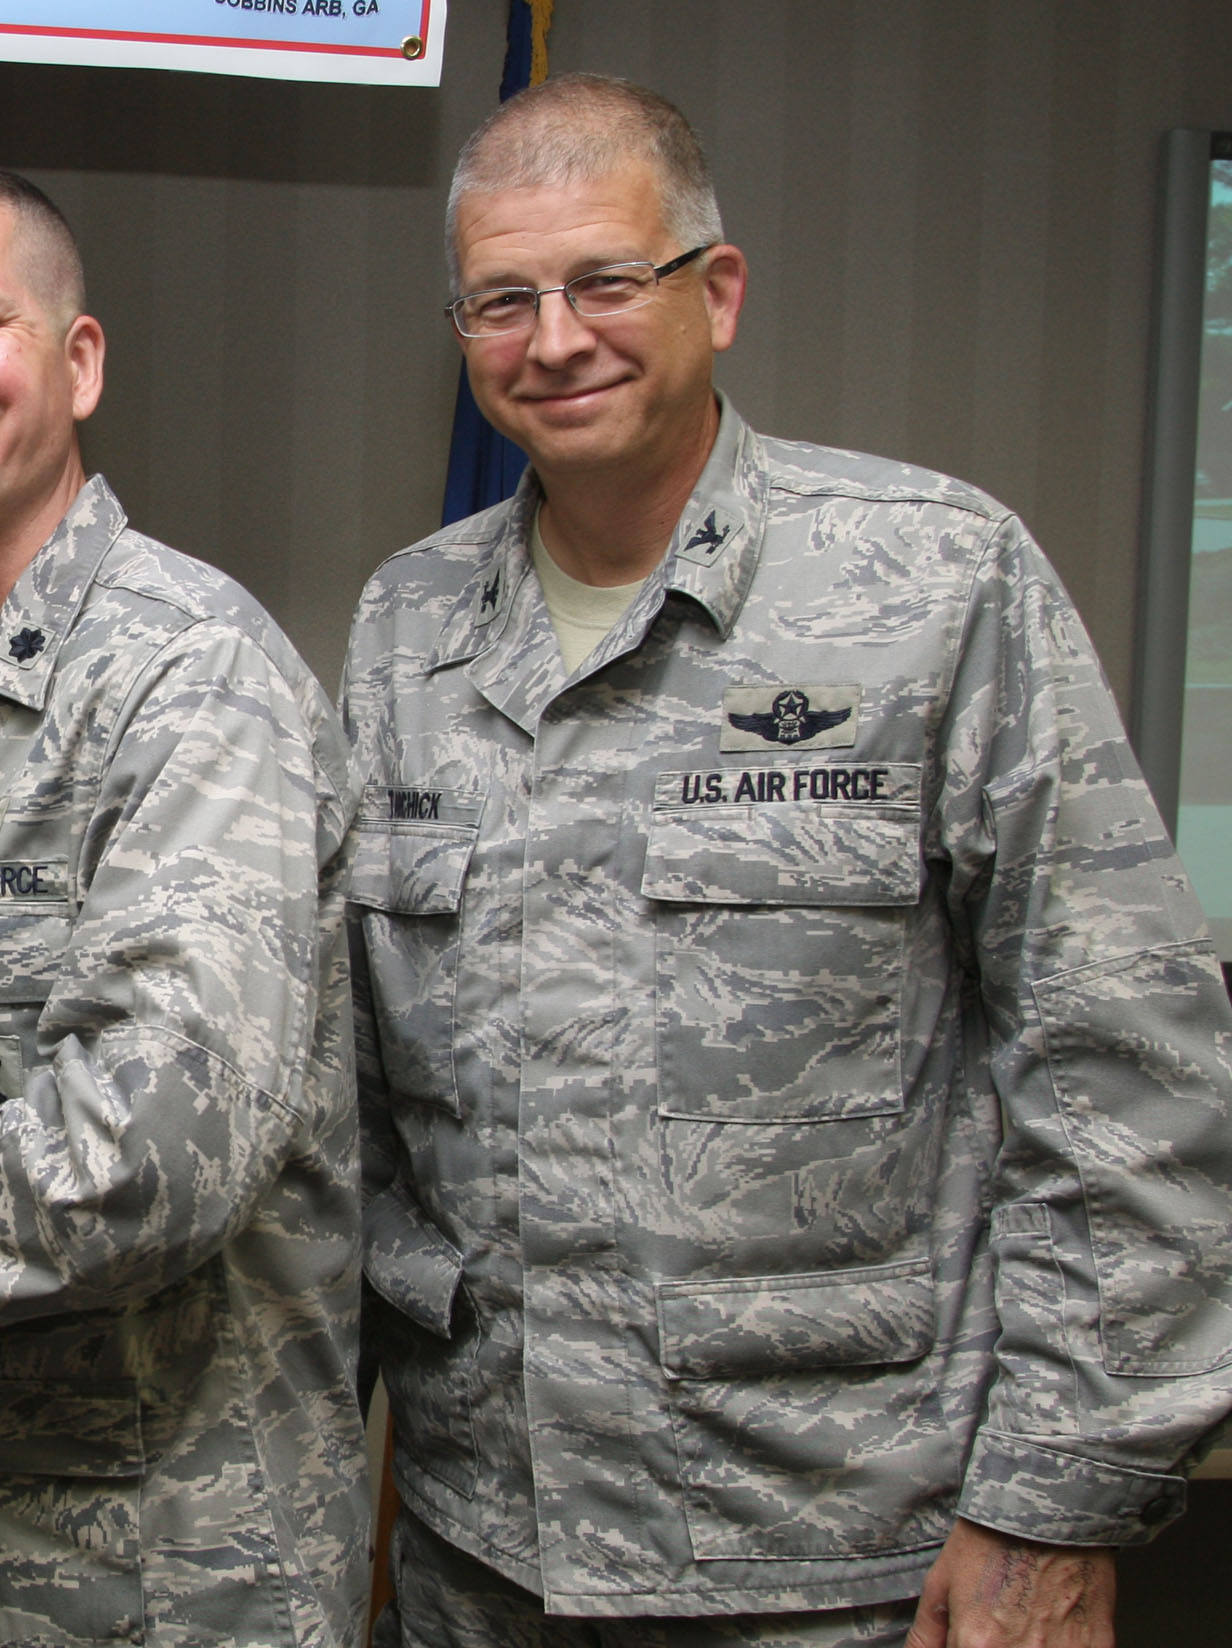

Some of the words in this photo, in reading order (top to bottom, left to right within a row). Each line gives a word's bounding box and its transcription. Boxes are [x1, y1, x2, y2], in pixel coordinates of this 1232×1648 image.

[215, 0, 297, 14] OBBINS
[302, 0, 347, 19] ARB,
[352, 0, 379, 16] GA
[682, 772, 727, 804] U.S.
[734, 771, 787, 803] AIR
[793, 768, 889, 801] FORCE
